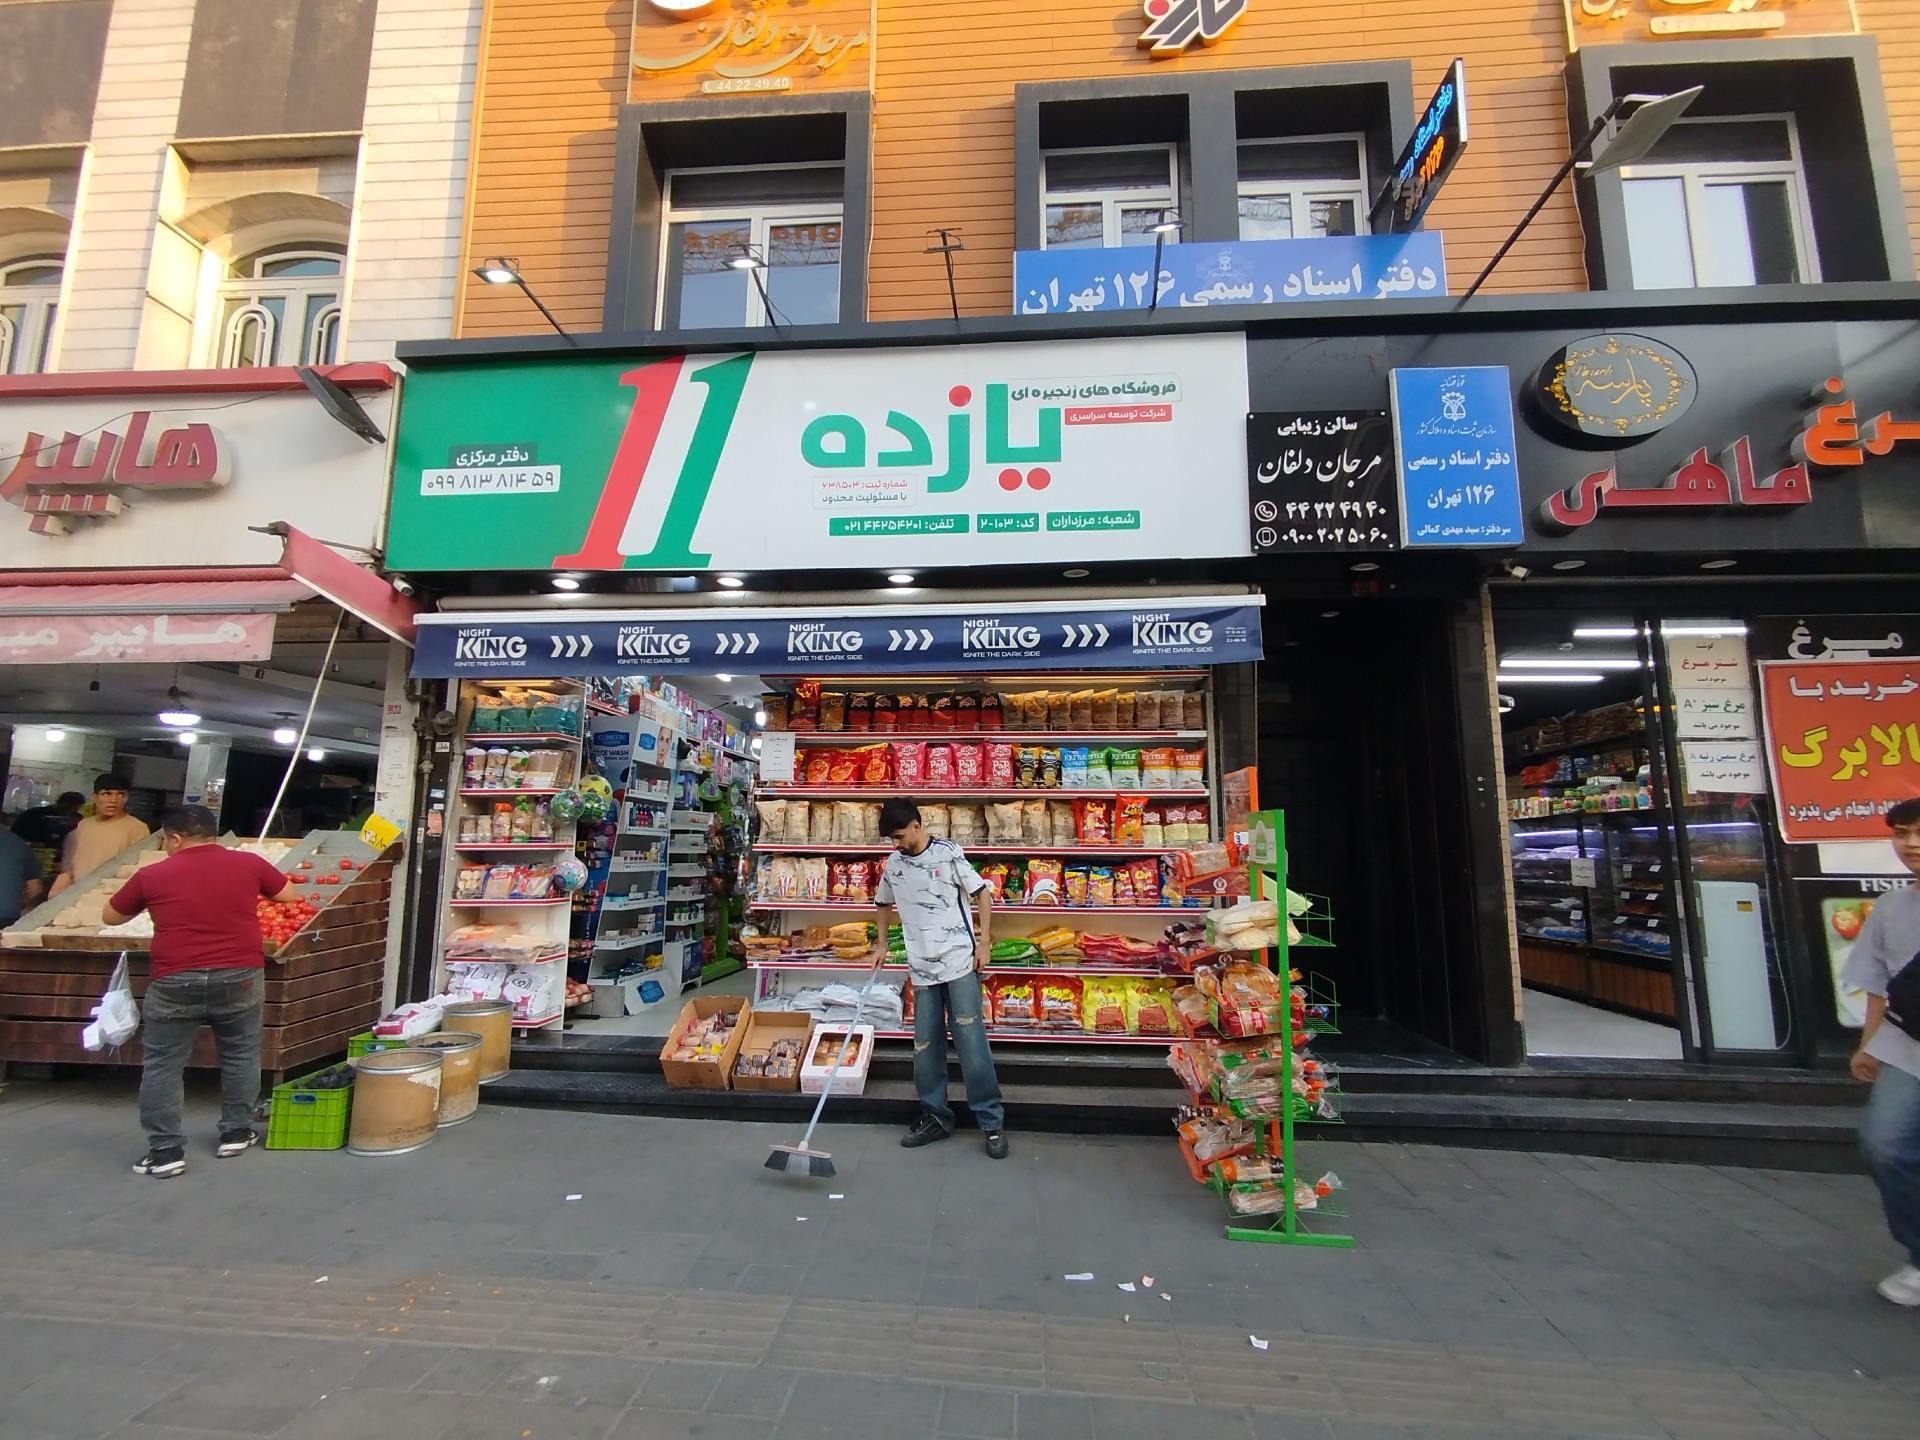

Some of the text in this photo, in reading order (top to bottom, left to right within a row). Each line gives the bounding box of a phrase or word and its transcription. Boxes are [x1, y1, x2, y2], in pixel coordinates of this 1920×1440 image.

[716, 77, 789, 90] 44 22 49 40
[1022, 259, 1438, 314] دفتر اسناد رسمی ۱۲۶ تهران
[1078, 383, 1110, 399] های
[1111, 379, 1177, 397] فروشگاه
[1575, 358, 1653, 407] پارسه
[1010, 386, 1029, 401] ای
[1069, 407, 1166, 422] شرکت توسعه سراسری
[1277, 416, 1358, 436] سالن زیبایی
[800, 383, 1062, 494] یازده
[456, 446, 529, 467] دفتر مرکزی
[1407, 447, 1511, 471] دفتر اسناد رسمی
[1257, 448, 1382, 488] مرجان دلفان
[882, 480, 908, 490] شماره
[1548, 435, 1812, 527] ماهی
[822, 491, 908, 504] با مسئولیت محدود
[1427, 484, 1495, 509] ۱۲۶ تهران
[1285, 501, 1386, 519] ۴۴ ۲۲ ۴۹ ۴۰
[924, 518, 955, 531] تلفن:
[1016, 517, 1035, 528] کد:
[1052, 512, 1135, 528] شعبه: مرزداران
[1281, 527, 1388, 544] ۰۹۰۰ ۲۰۲ ۵۰ ۶۰
[1417, 524, 1440, 536] کمالی
[1441, 525, 1464, 536] مهدی
[1464, 525, 1480, 536] سید
[963, 619, 1000, 628] NIGHT
[1132, 613, 1170, 622] NIGHT
[459, 628, 492, 637] NIGHT
[619, 626, 655, 634] NIGHT
[789, 624, 826, 632] NIGHT
[1132, 621, 1213, 646] KING
[617, 633, 691, 656] KING
[787, 631, 863, 653] KING
[963, 626, 1041, 649] KING
[1788, 620, 1903, 659] مرغ
[456, 636, 528, 659] KING
[1681, 656, 1710, 670] مرغ
[1789, 673, 1919, 701] خرید با
[1723, 697, 1746, 712] مرغ
[1823, 804, 1842, 821] می
[1845, 800, 1875, 820] انجام
